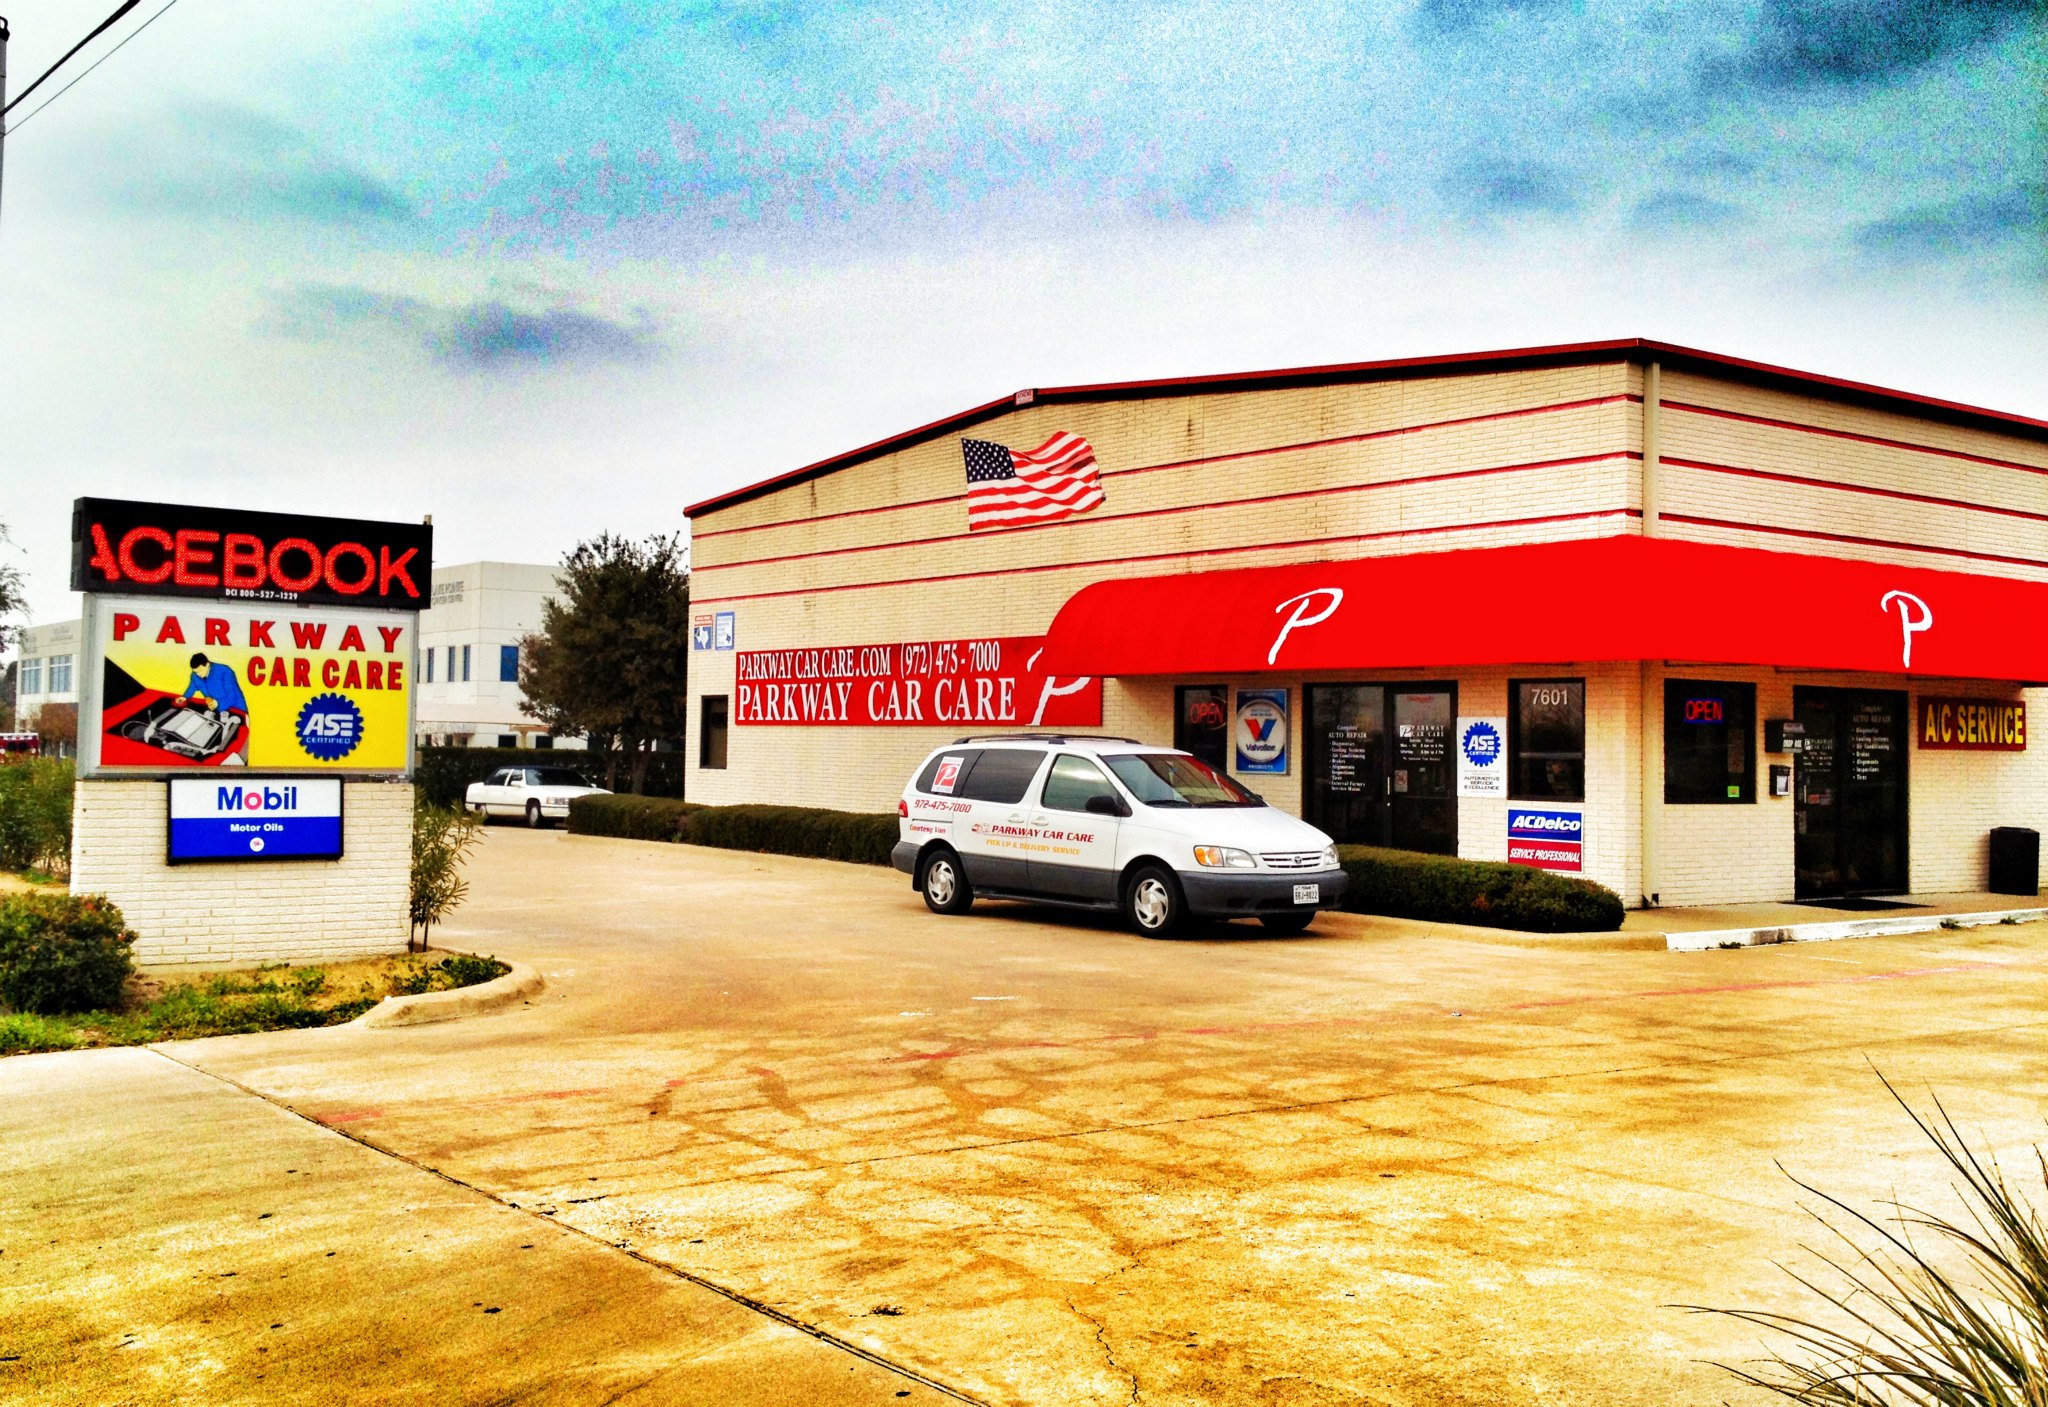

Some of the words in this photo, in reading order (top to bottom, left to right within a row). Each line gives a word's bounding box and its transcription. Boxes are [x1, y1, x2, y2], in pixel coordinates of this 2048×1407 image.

[240, 589, 298, 600] 800-527-1229
[113, 613, 403, 653] PARKWAY
[1268, 588, 1344, 665] P
[1881, 590, 1933, 668] P
[738, 652, 794, 680] PARKWAY
[795, 650, 820, 679] CAR
[900, 641, 932, 679] (972)
[247, 656, 311, 687] CAR
[322, 659, 403, 690] CARE
[737, 682, 852, 721] PARKWAY
[867, 679, 923, 721] CAR
[934, 677, 1016, 721] CARE
[1531, 689, 1568, 706] 7601
[1189, 702, 1223, 724] OPEN
[1685, 700, 1722, 720] OPEN
[303, 713, 354, 737] ASE
[1925, 704, 1952, 743] A/C
[1957, 705, 2024, 744] SERVICE
[1246, 743, 1276, 751] Valvoline
[1467, 735, 1495, 751] ASE
[218, 787, 297, 810] Mobil
[914, 800, 972, 813] 972-475-7000
[230, 823, 261, 832] Motor
[263, 823, 284, 832] Oils
[909, 825, 933, 834] Courtesy
[1511, 815, 1581, 831] ACDelco
[992, 825, 1041, 838] PARKWAY
[1043, 830, 1064, 840] CAR
[1066, 832, 1095, 843] CARE
[1019, 843, 1050, 852] DELIVERY
[1052, 846, 1081, 855] SERVICE
[1509, 847, 1535, 859] SERVICE
[1534, 849, 1580, 863] PROFESSIONAL
